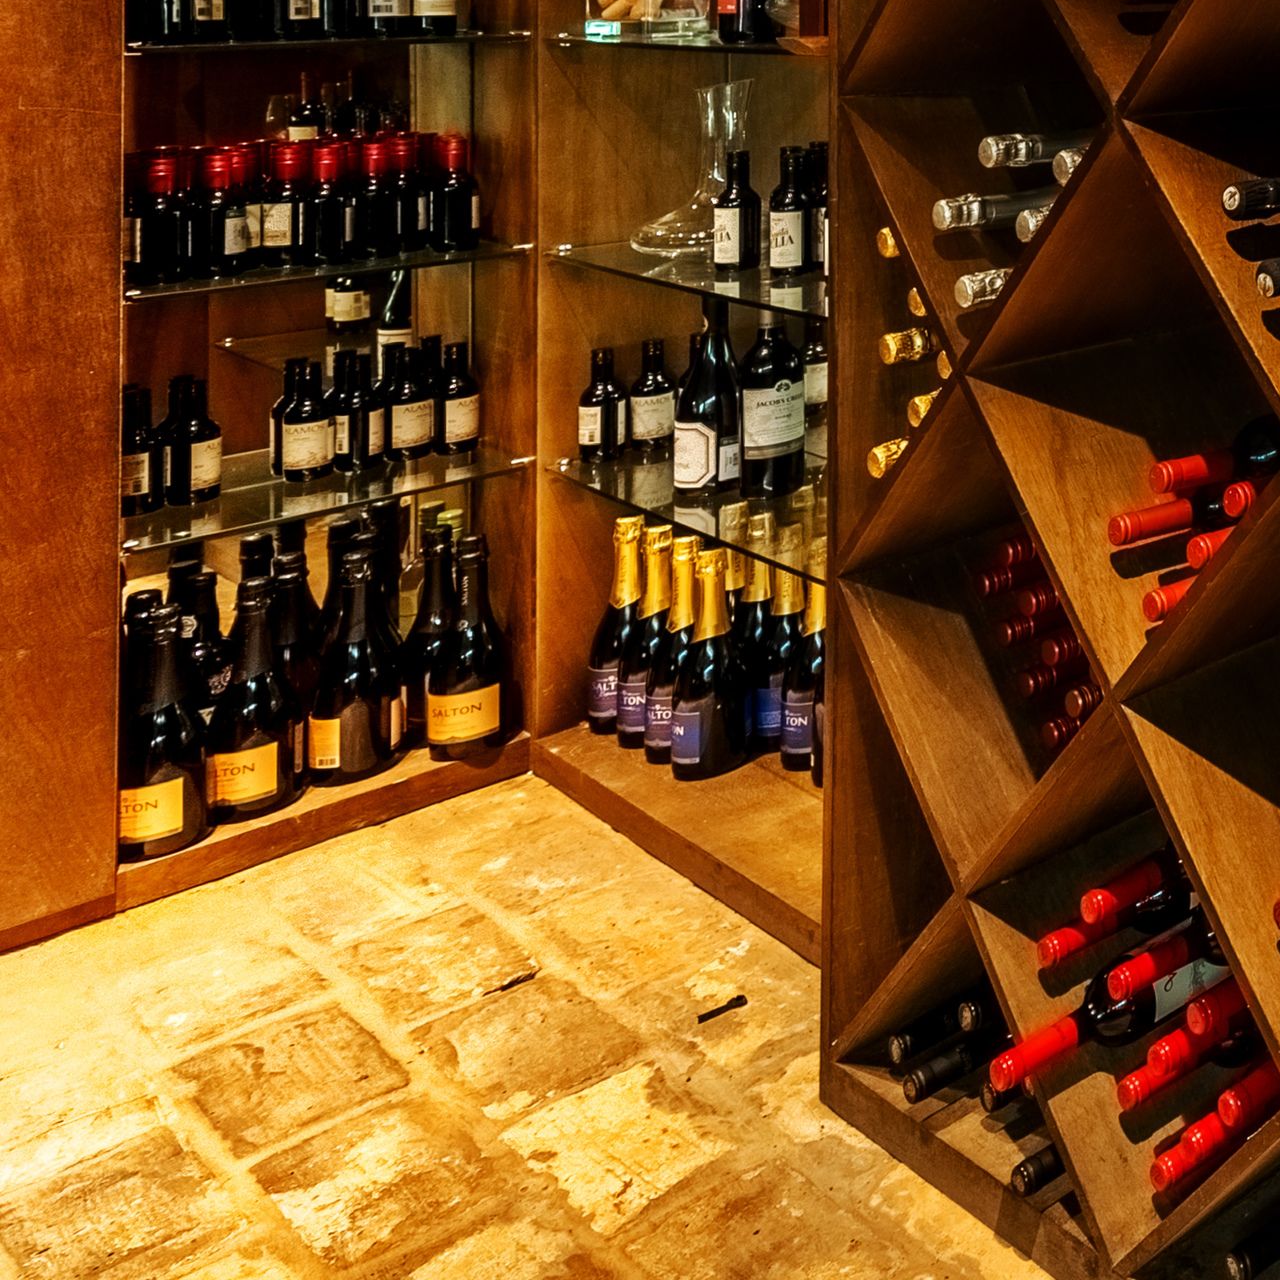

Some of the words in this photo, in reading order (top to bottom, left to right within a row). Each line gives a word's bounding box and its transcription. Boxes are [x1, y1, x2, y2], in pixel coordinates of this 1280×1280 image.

[623, 695, 646, 707] TON
[431, 702, 482, 719] SALTON
[786, 716, 808, 728] TON
